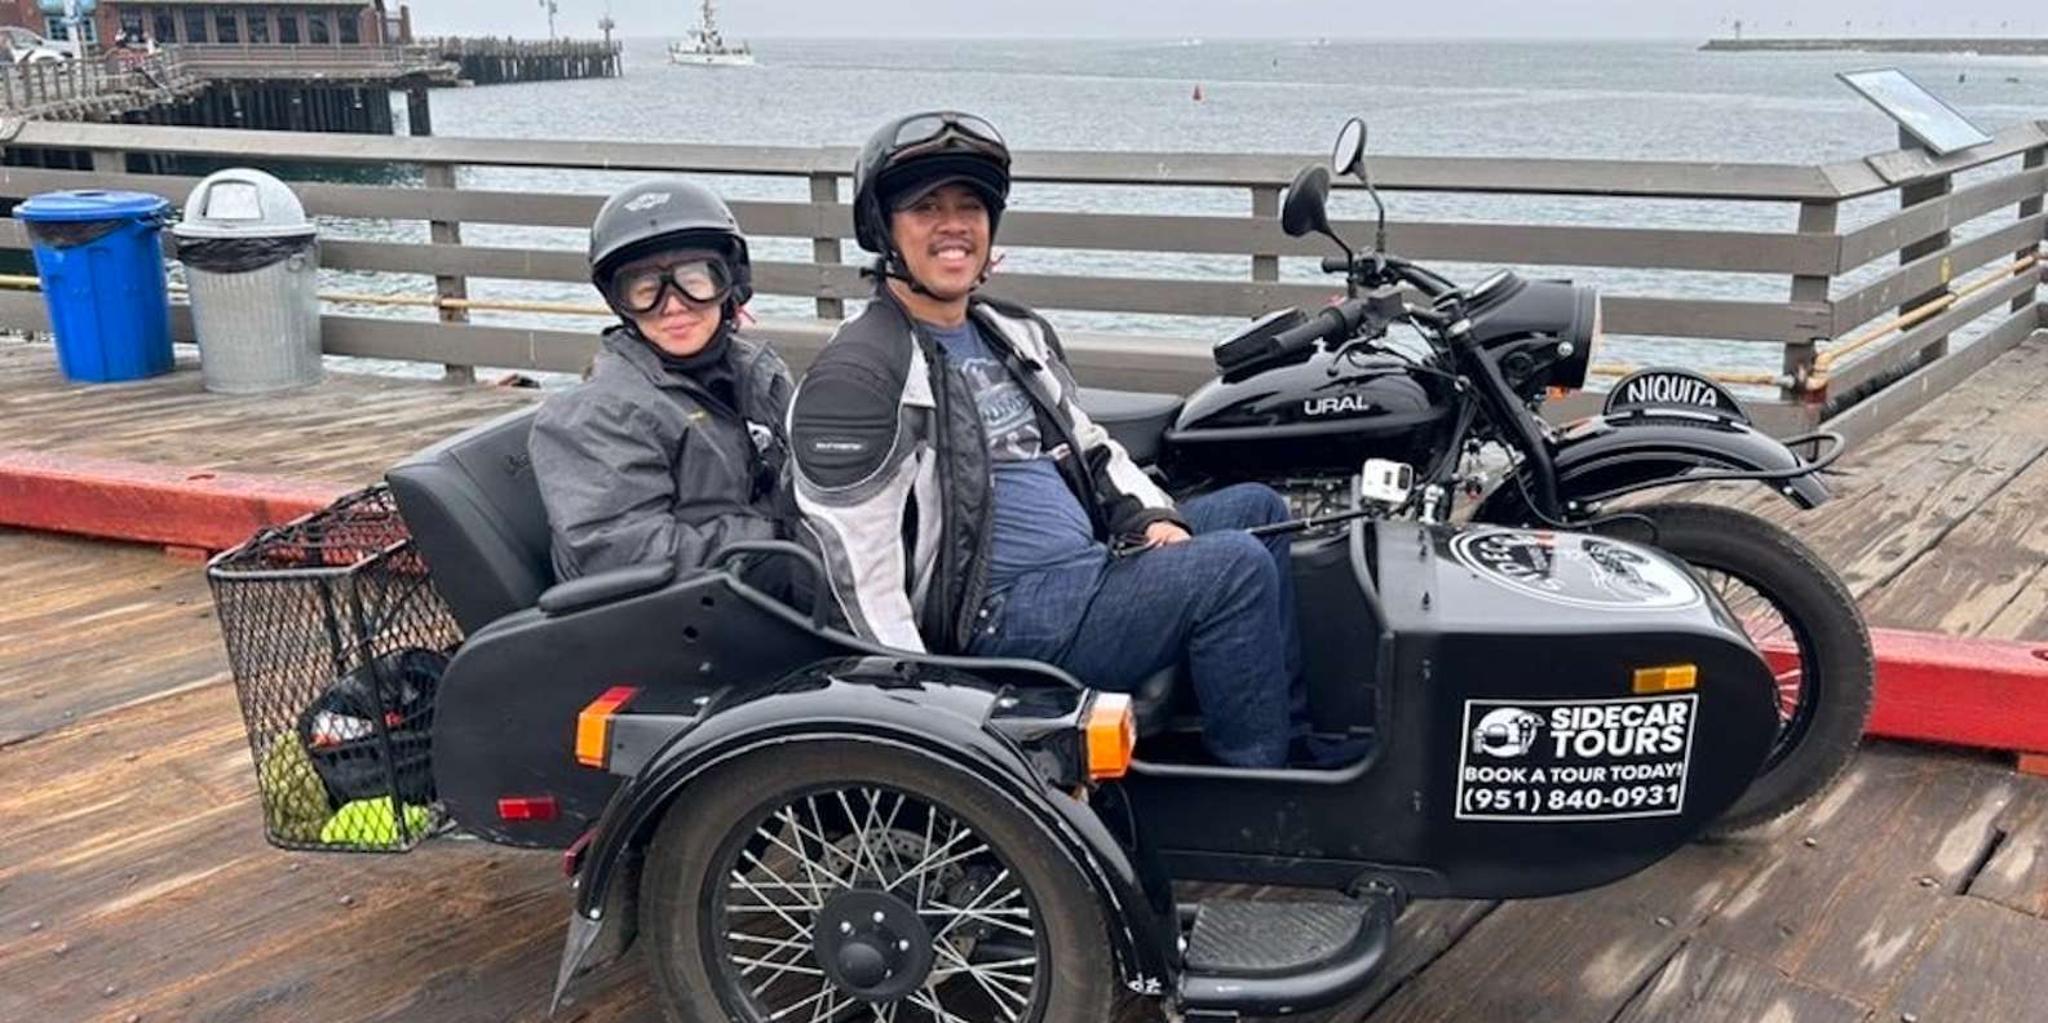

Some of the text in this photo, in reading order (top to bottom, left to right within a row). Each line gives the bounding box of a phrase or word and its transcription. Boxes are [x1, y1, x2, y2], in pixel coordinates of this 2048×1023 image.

[1627, 375, 1718, 407] NIQUITA
[1304, 395, 1369, 416] URAL
[1550, 702, 1688, 730] SIDECAR
[1550, 725, 1685, 758] TOURS
[1464, 762, 1683, 783] BOOK A TOUR TODAY!
[1464, 784, 1679, 812] (951) 840-0931
